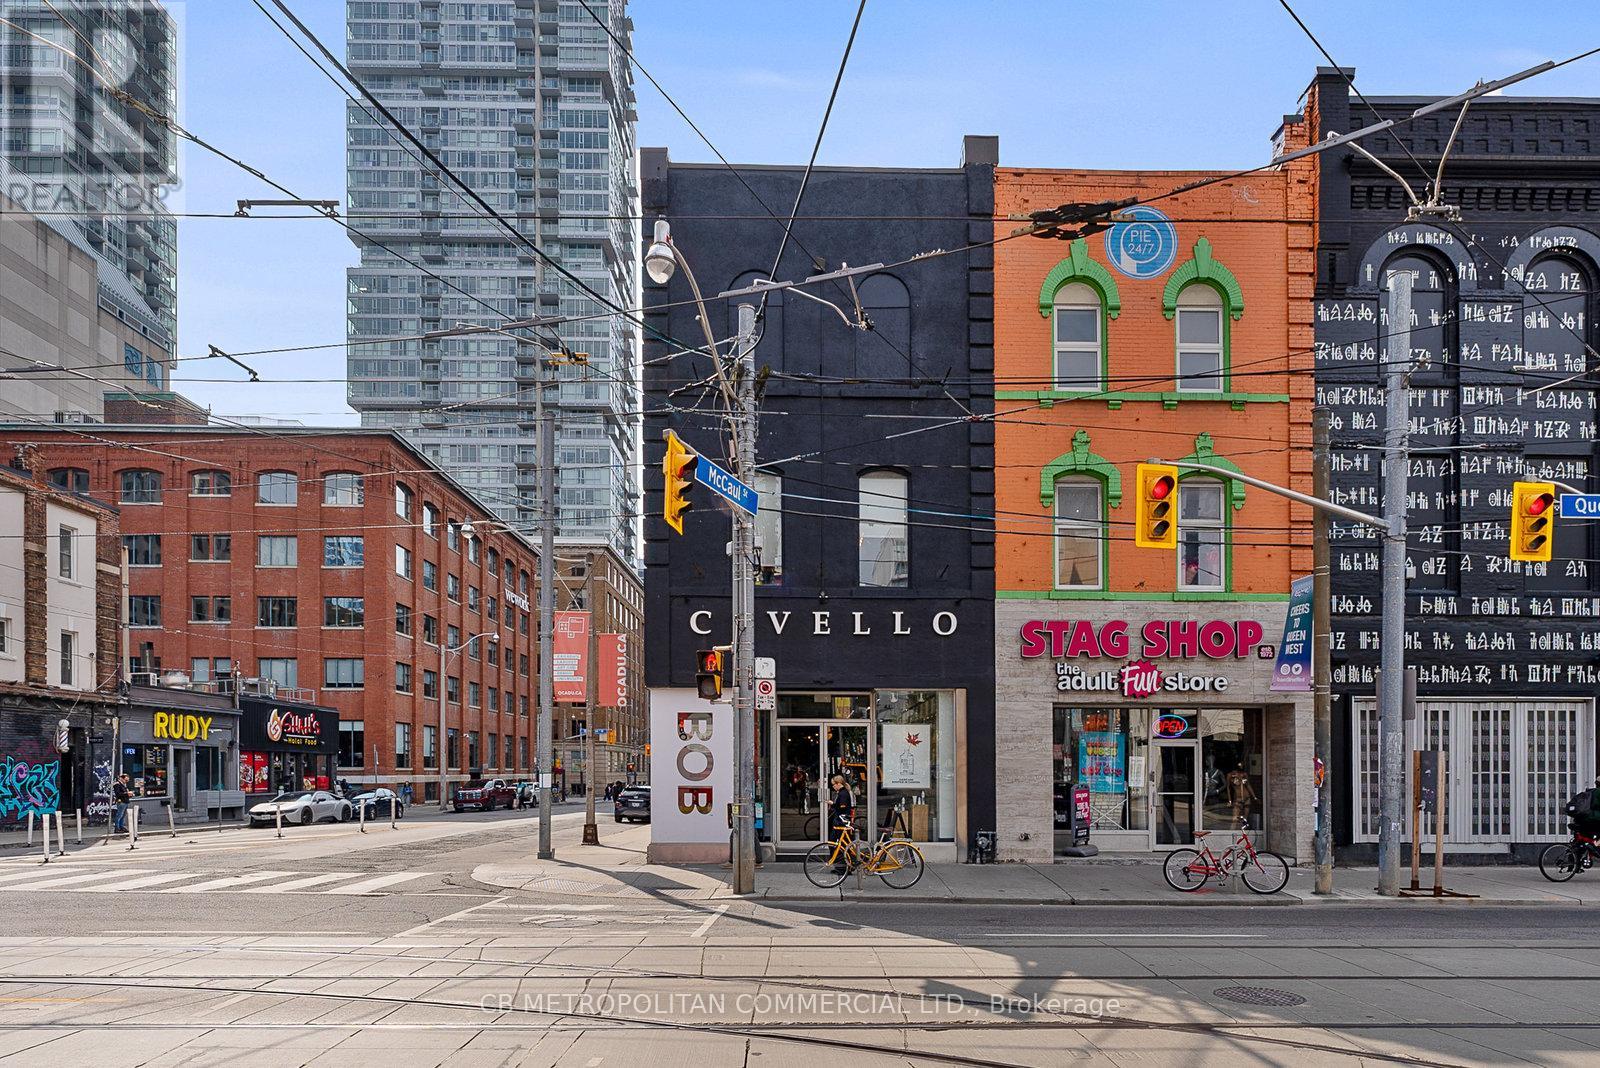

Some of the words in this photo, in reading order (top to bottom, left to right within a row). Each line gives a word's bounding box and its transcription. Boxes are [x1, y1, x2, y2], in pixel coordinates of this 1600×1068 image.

[1130, 230, 1152, 243] PIE
[1128, 243, 1154, 255] 24/7
[708, 465, 741, 501] McCaul
[1574, 497, 1600, 515] Qu
[1290, 603, 1311, 617] CHEERS
[690, 610, 959, 636] CVELLO
[1293, 618, 1301, 629] TO
[1020, 620, 1130, 658] STAG
[1143, 620, 1264, 659] SHOP
[1286, 629, 1307, 643] QUEEN
[1285, 643, 1304, 656] WEST
[616, 633, 628, 707] OCADU.CA
[1056, 662, 1081, 676] the
[1056, 672, 1119, 692] adult
[1120, 664, 1162, 697] Fun
[1164, 672, 1229, 692] store
[154, 711, 213, 741] RUDY
[1154, 720, 1185, 733] OPEN
[677, 712, 714, 815] BOB
